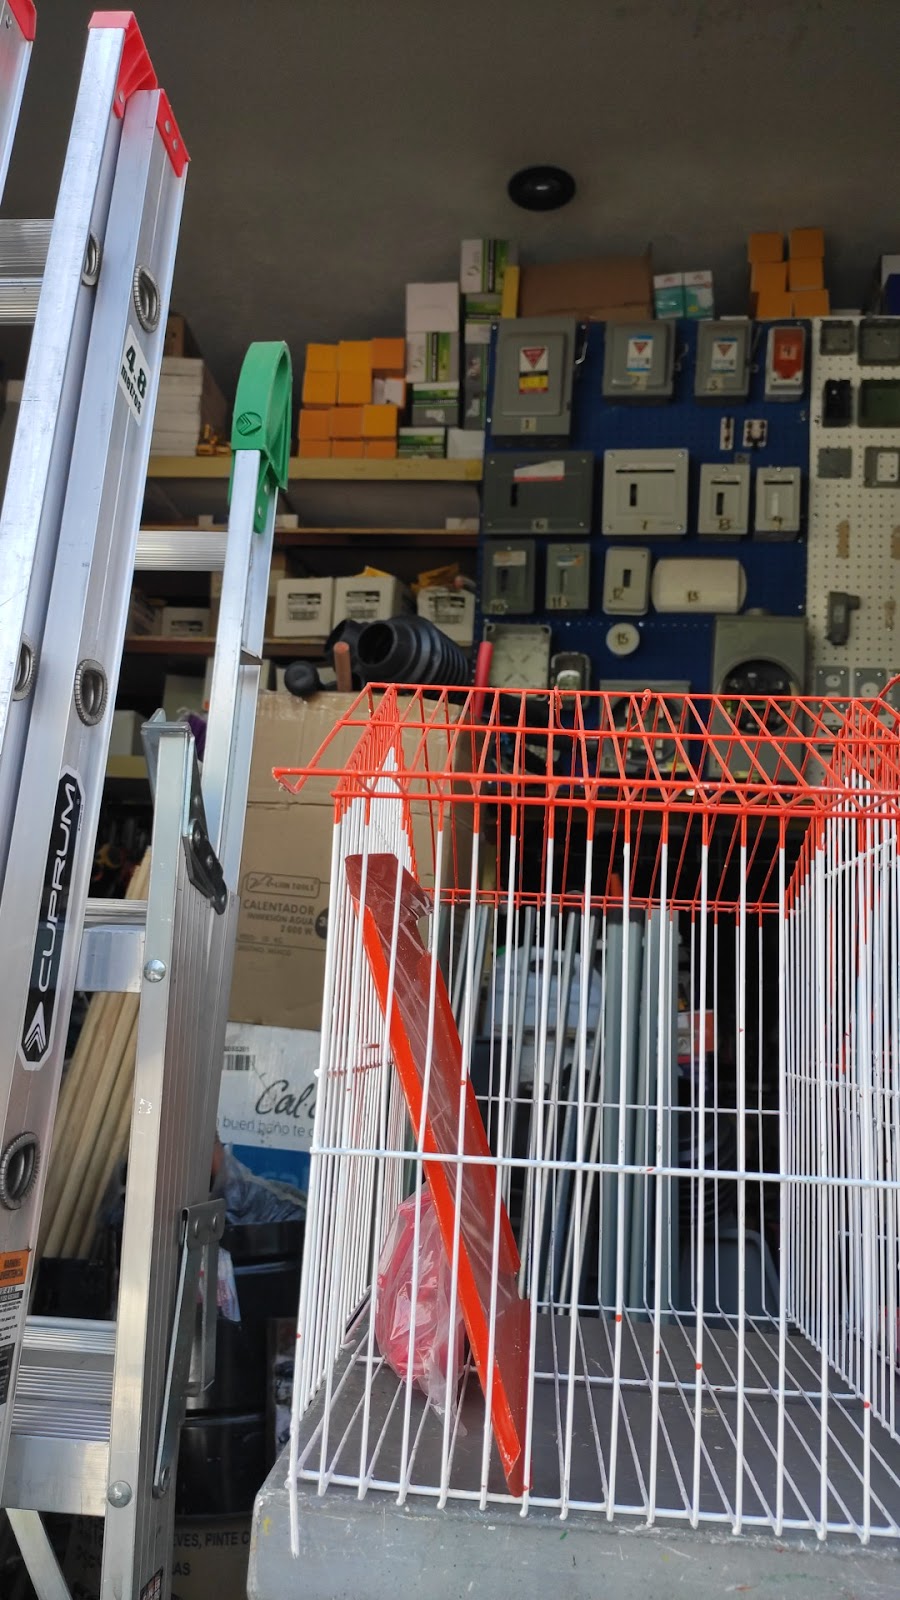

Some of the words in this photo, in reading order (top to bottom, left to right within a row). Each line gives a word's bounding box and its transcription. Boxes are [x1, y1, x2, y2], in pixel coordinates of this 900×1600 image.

[126, 344, 147, 400] 4.8
[120, 364, 141, 415] metros
[39, 782, 76, 993] CUPRUM
[243, 899, 315, 916] CALENTADOR
[289, 916, 315, 926] AGUA
[222, 1116, 254, 1131] buen
[293, 1125, 306, 1137] te
[205, 1531, 239, 1546] PINTE
